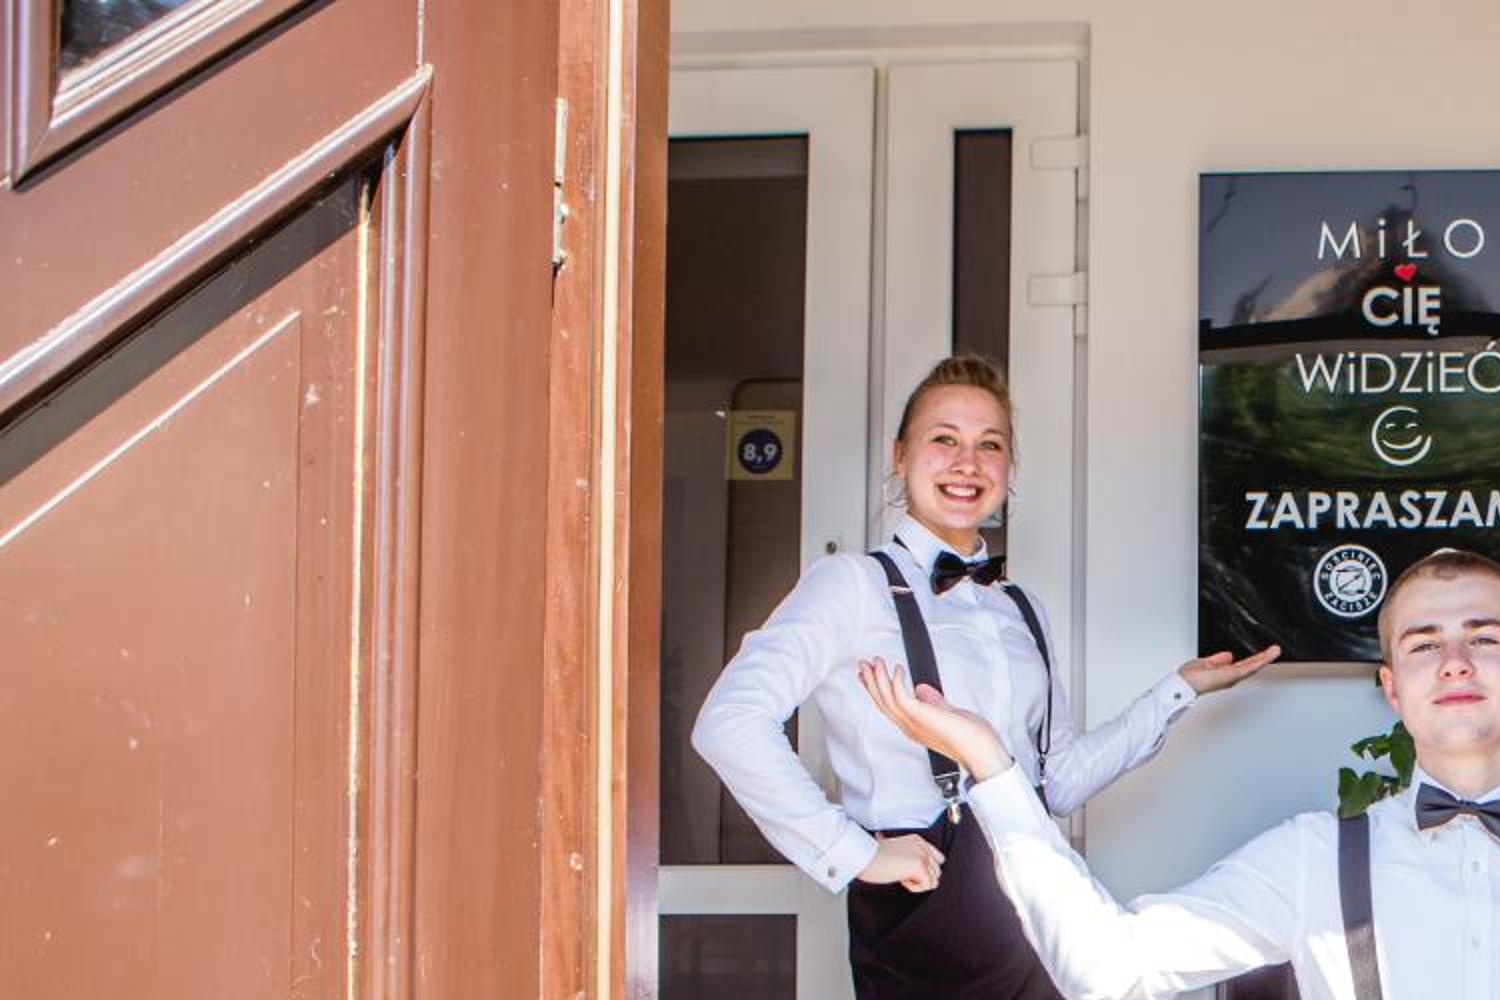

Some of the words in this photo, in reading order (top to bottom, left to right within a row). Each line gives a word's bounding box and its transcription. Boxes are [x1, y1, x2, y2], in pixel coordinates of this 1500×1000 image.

[1316, 217, 1485, 261] MiŁO
[1361, 286, 1442, 335] CIĘ
[743, 442, 778, 464] 8,9
